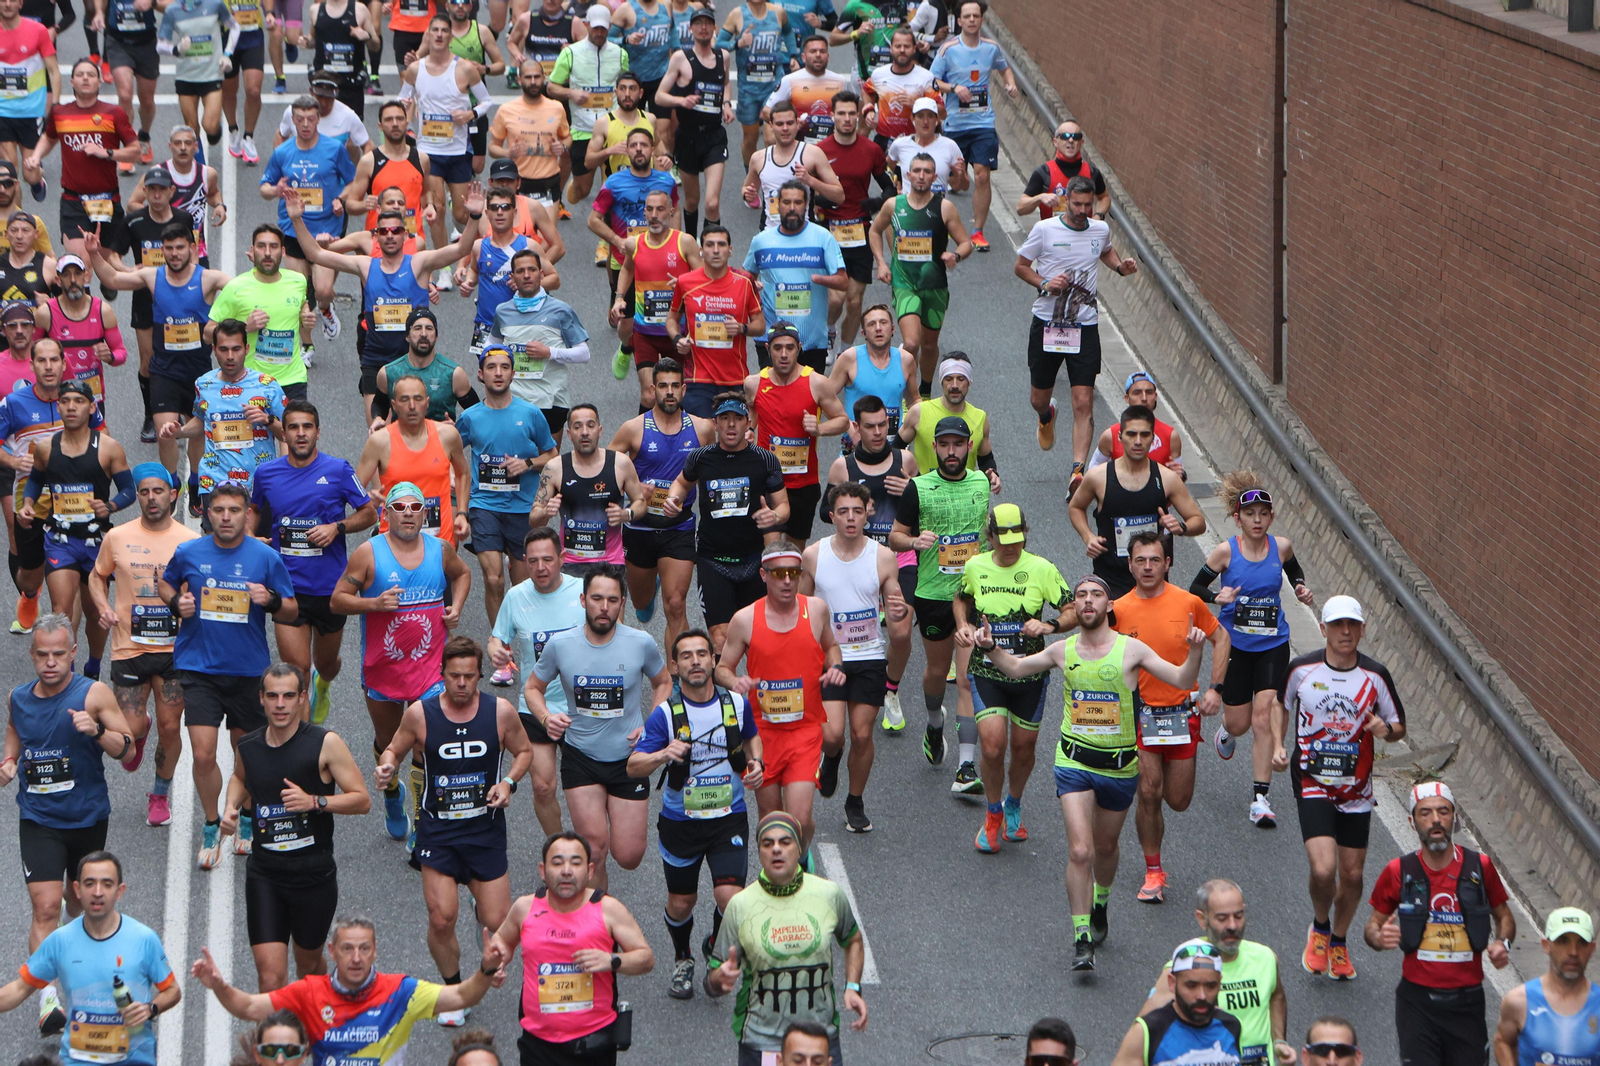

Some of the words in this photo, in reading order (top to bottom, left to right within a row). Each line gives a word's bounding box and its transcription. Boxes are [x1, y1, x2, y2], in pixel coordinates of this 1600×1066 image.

[64, 133, 102, 144] QATAR
[775, 252, 820, 263] Montellano
[705, 295, 733, 303] Catalana
[705, 302, 737, 310] Occidente
[720, 478, 745, 487] ZURICH
[64, 484, 89, 492] ZURICH
[721, 492, 736, 500] 2809
[1129, 516, 1154, 525] ZURICH
[291, 531, 307, 539] 3385
[953, 535, 975, 544] ZURICH
[130, 561, 154, 569] Maratón
[219, 581, 246, 589] ZURICH
[147, 606, 172, 614] ZURIC
[850, 611, 873, 620] ZURICH
[146, 620, 163, 628] 2671
[847, 635, 869, 643] ALBERTO
[590, 677, 618, 685] ZURICH
[771, 681, 797, 689] ZURICH
[590, 691, 607, 700] 2522
[590, 702, 609, 710] JULIEN
[1155, 719, 1172, 727] 3074
[1325, 727, 1352, 739] Sierra
[34, 749, 62, 758] ZURICH
[438, 740, 488, 760] GD
[1323, 757, 1341, 766] 2735
[36, 765, 54, 774] 3123
[451, 775, 479, 784] ZURICH
[700, 776, 726, 785] ZURICH
[452, 791, 469, 800] 3444
[700, 791, 718, 800] 1856
[274, 821, 292, 831] 2540
[274, 833, 298, 842] CARLOS
[771, 925, 810, 935] IMPERIAL
[771, 932, 813, 945] TARRACO
[555, 964, 582, 973] ZURIC
[555, 981, 574, 990] 3721
[1220, 979, 1257, 990] CTUALLY
[1226, 990, 1260, 1010] RUN
[90, 1014, 123, 1024] ZURICH
[323, 1029, 380, 1043] PALACIEGO
[1243, 1046, 1263, 1056] URICH
[1558, 1056, 1592, 1065] ZURICH
